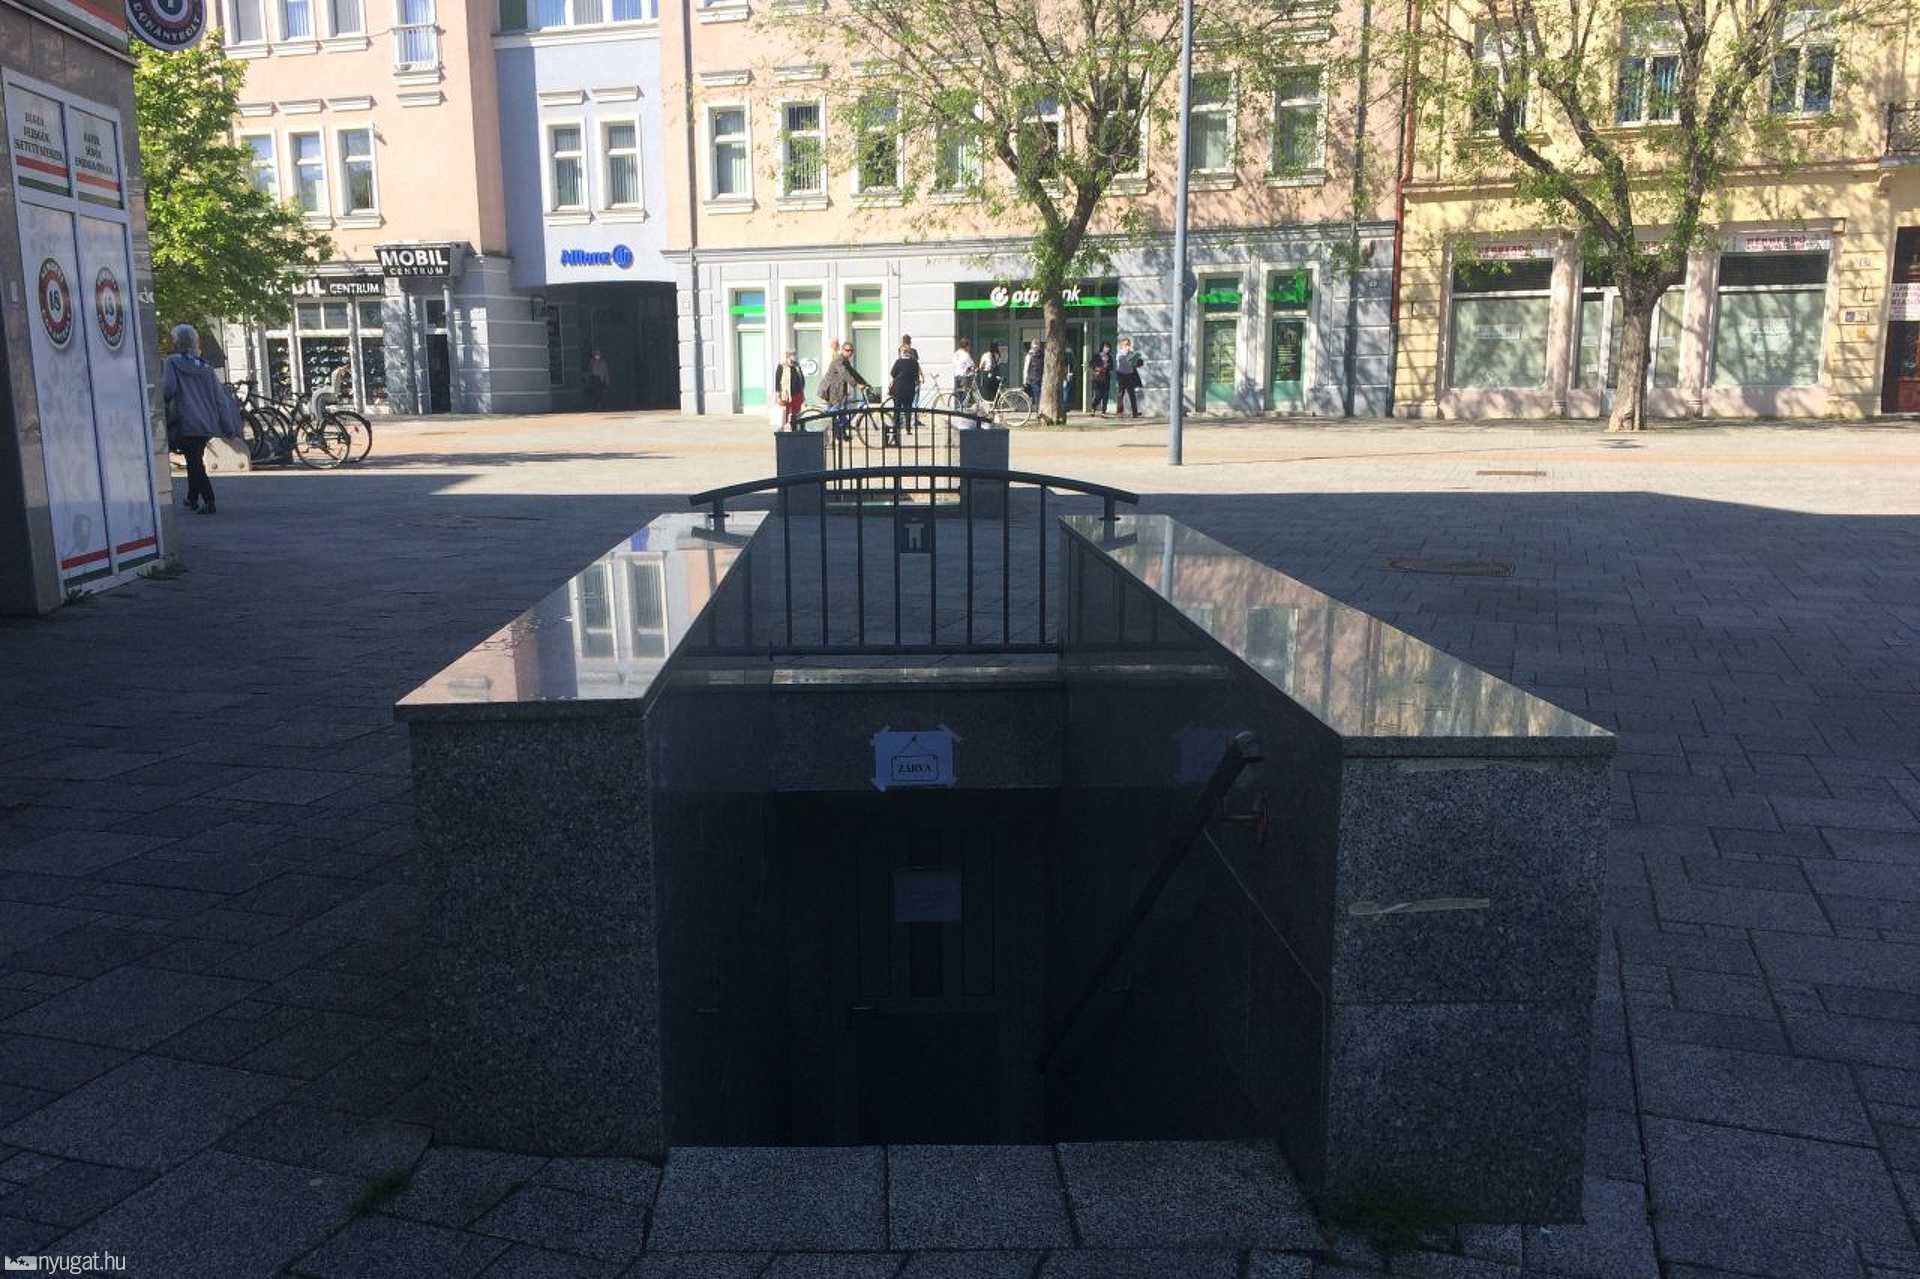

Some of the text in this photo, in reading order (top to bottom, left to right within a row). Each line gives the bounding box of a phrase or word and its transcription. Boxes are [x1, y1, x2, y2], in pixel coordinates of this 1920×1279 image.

[381, 249, 449, 267] MOBIL
[560, 249, 612, 267] Allianz
[390, 266, 444, 275] CENTRUM
[329, 282, 380, 295] CENTRUM
